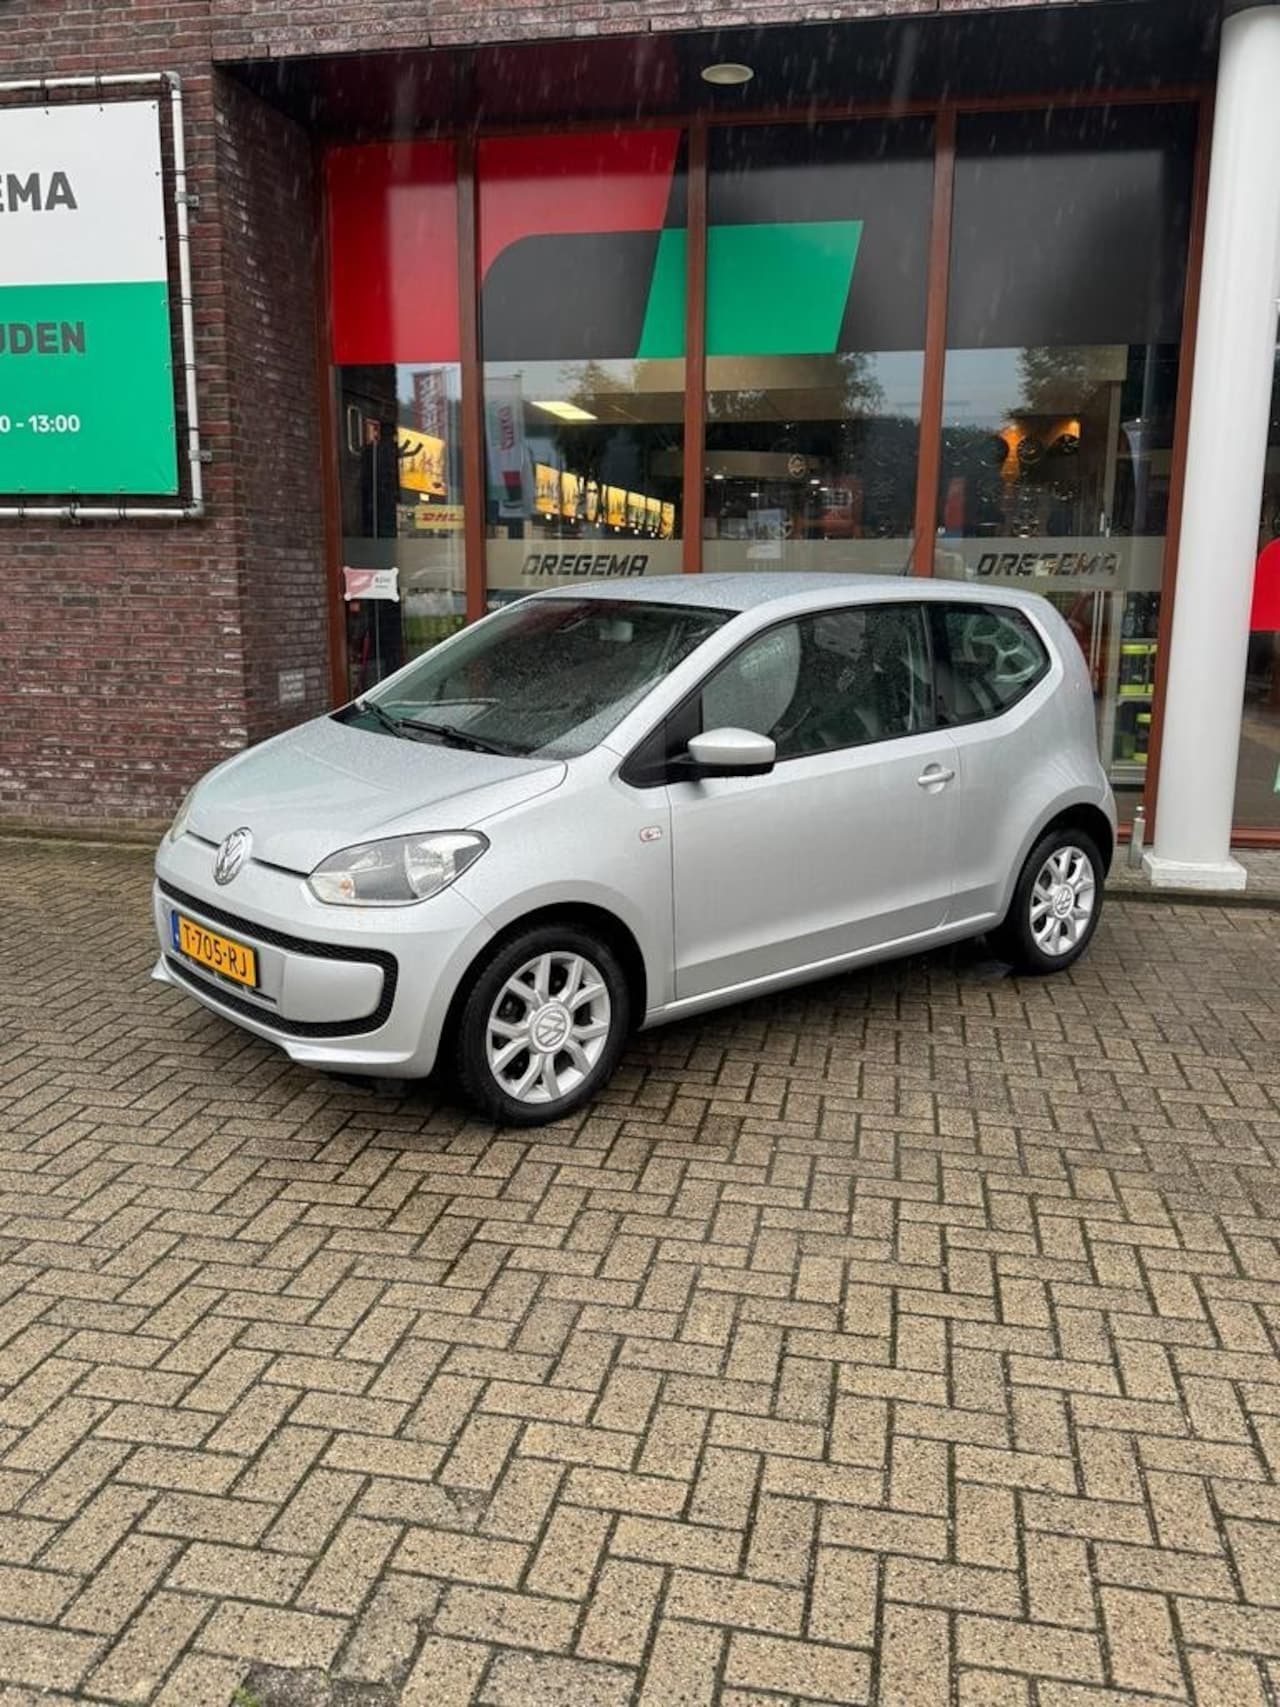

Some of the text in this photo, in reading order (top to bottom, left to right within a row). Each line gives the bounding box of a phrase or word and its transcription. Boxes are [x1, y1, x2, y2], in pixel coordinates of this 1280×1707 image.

[0, 171, 78, 213] MA
[0, 320, 86, 354] DEN
[28, 414, 80, 433] 13:00
